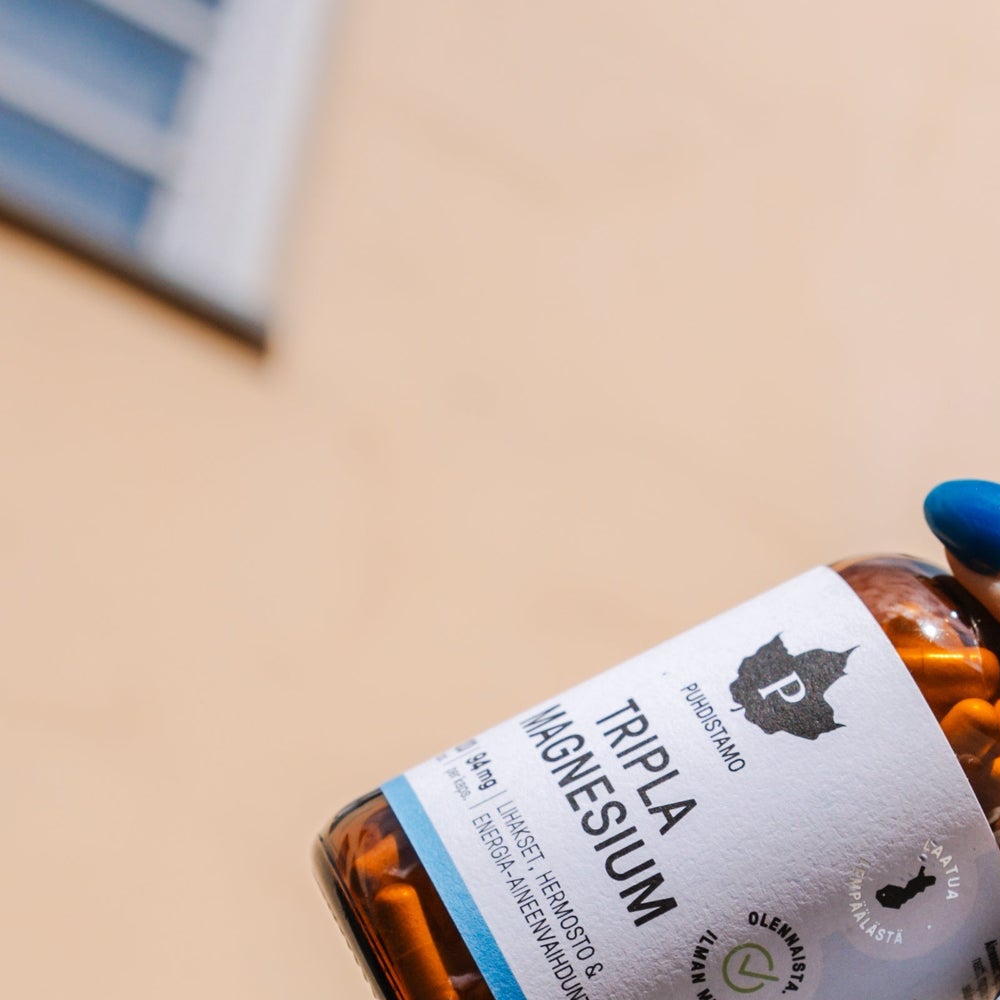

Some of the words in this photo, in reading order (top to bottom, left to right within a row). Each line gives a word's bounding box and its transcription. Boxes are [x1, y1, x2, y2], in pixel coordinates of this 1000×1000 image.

[758, 671, 806, 703] P
[466, 752, 491, 771] 94
[680, 682, 746, 773] PUHDISTAMO
[476, 768, 497, 791] mg
[596, 698, 697, 836] TRIPLA
[519, 703, 678, 927] MAGNESIUM
[497, 800, 545, 871] LIHAKSET,
[536, 871, 595, 961] HERMOSTO
[585, 962, 604, 979] &
[923, 838, 961, 900] LAATUA
[691, 929, 718, 984] ILMAN
[748, 911, 806, 994] OLENNAISTA.
